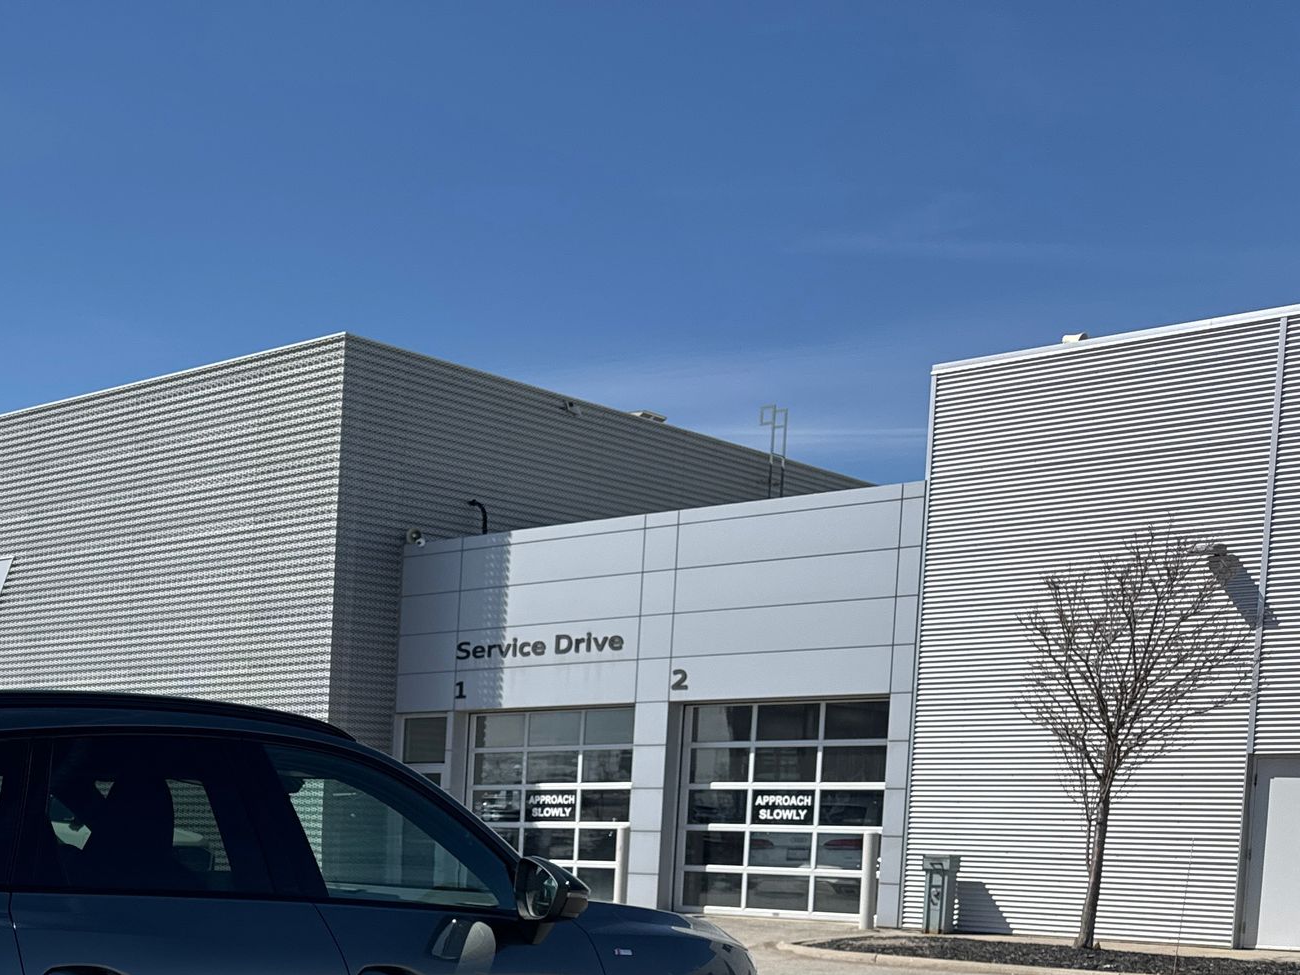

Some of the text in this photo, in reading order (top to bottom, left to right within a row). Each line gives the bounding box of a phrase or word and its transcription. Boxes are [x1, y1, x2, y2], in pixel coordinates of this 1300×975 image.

[456, 632, 624, 660] Service Drive
[671, 669, 688, 691] 2
[454, 681, 467, 699] 1
[528, 794, 576, 805] APPROACH
[755, 795, 812, 806] APPROACH
[531, 807, 572, 817] SLOWLY
[758, 808, 808, 820] SLOWLY
